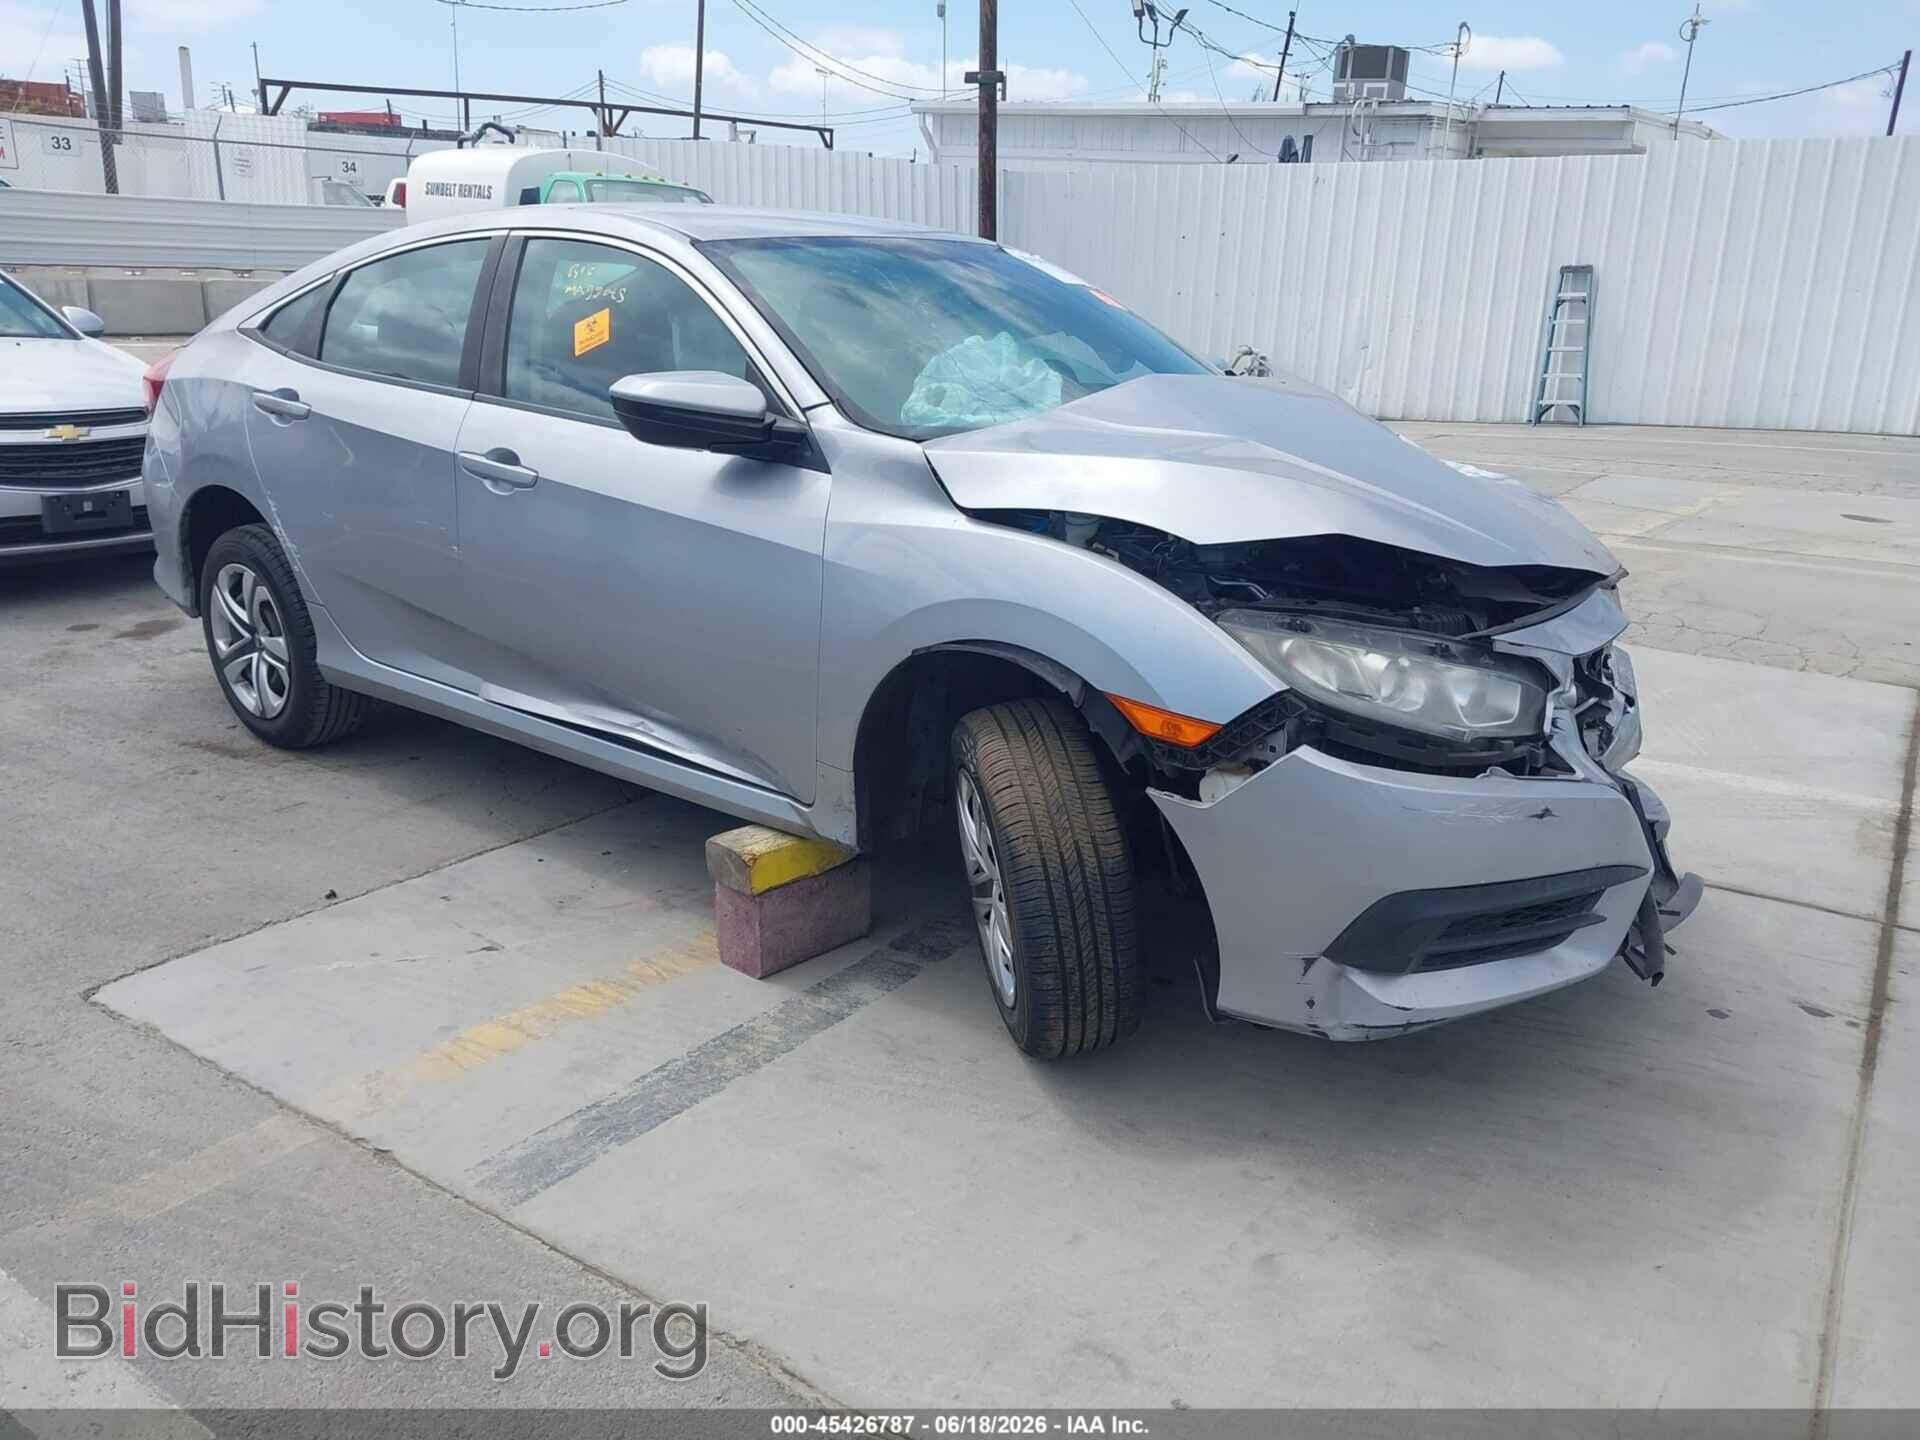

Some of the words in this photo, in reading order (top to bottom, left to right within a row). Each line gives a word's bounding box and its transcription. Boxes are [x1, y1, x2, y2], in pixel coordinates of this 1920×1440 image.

[51, 136, 72, 151] 33
[341, 161, 357, 173] 34
[425, 181, 457, 197] SUNBELT
[458, 183, 493, 200] RENTALS
